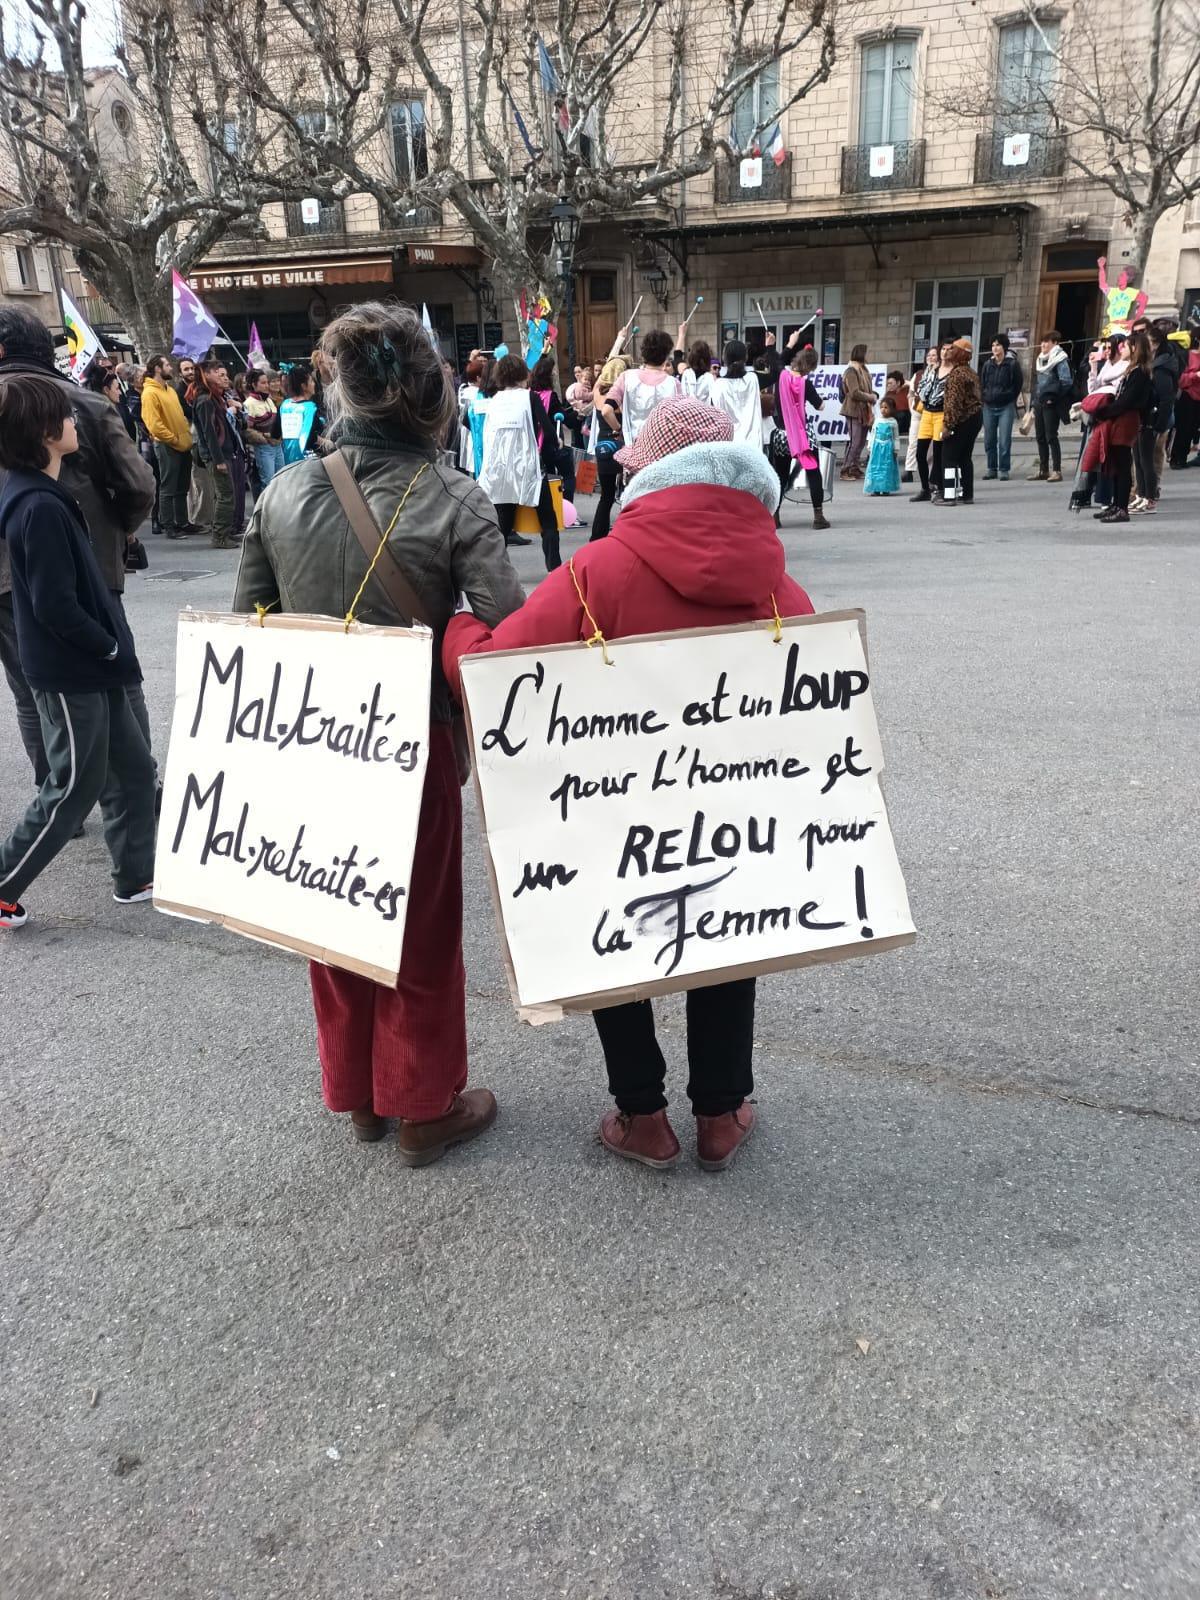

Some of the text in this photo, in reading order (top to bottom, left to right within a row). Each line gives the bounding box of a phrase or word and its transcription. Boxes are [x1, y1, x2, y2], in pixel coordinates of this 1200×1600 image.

[203, 274, 257, 289] L'HOTEL
[262, 274, 281, 285] DE
[285, 271, 324, 283] VILLE
[415, 248, 435, 260] PMU
[749, 295, 813, 312] MAIRIE
[682, 671, 732, 726] est
[739, 694, 773, 717] un
[779, 642, 869, 715] LOUP
[549, 736, 872, 821] pour L'homme et
[512, 810, 876, 898] un RELOU pour
[592, 865, 875, 976] la Femme !
